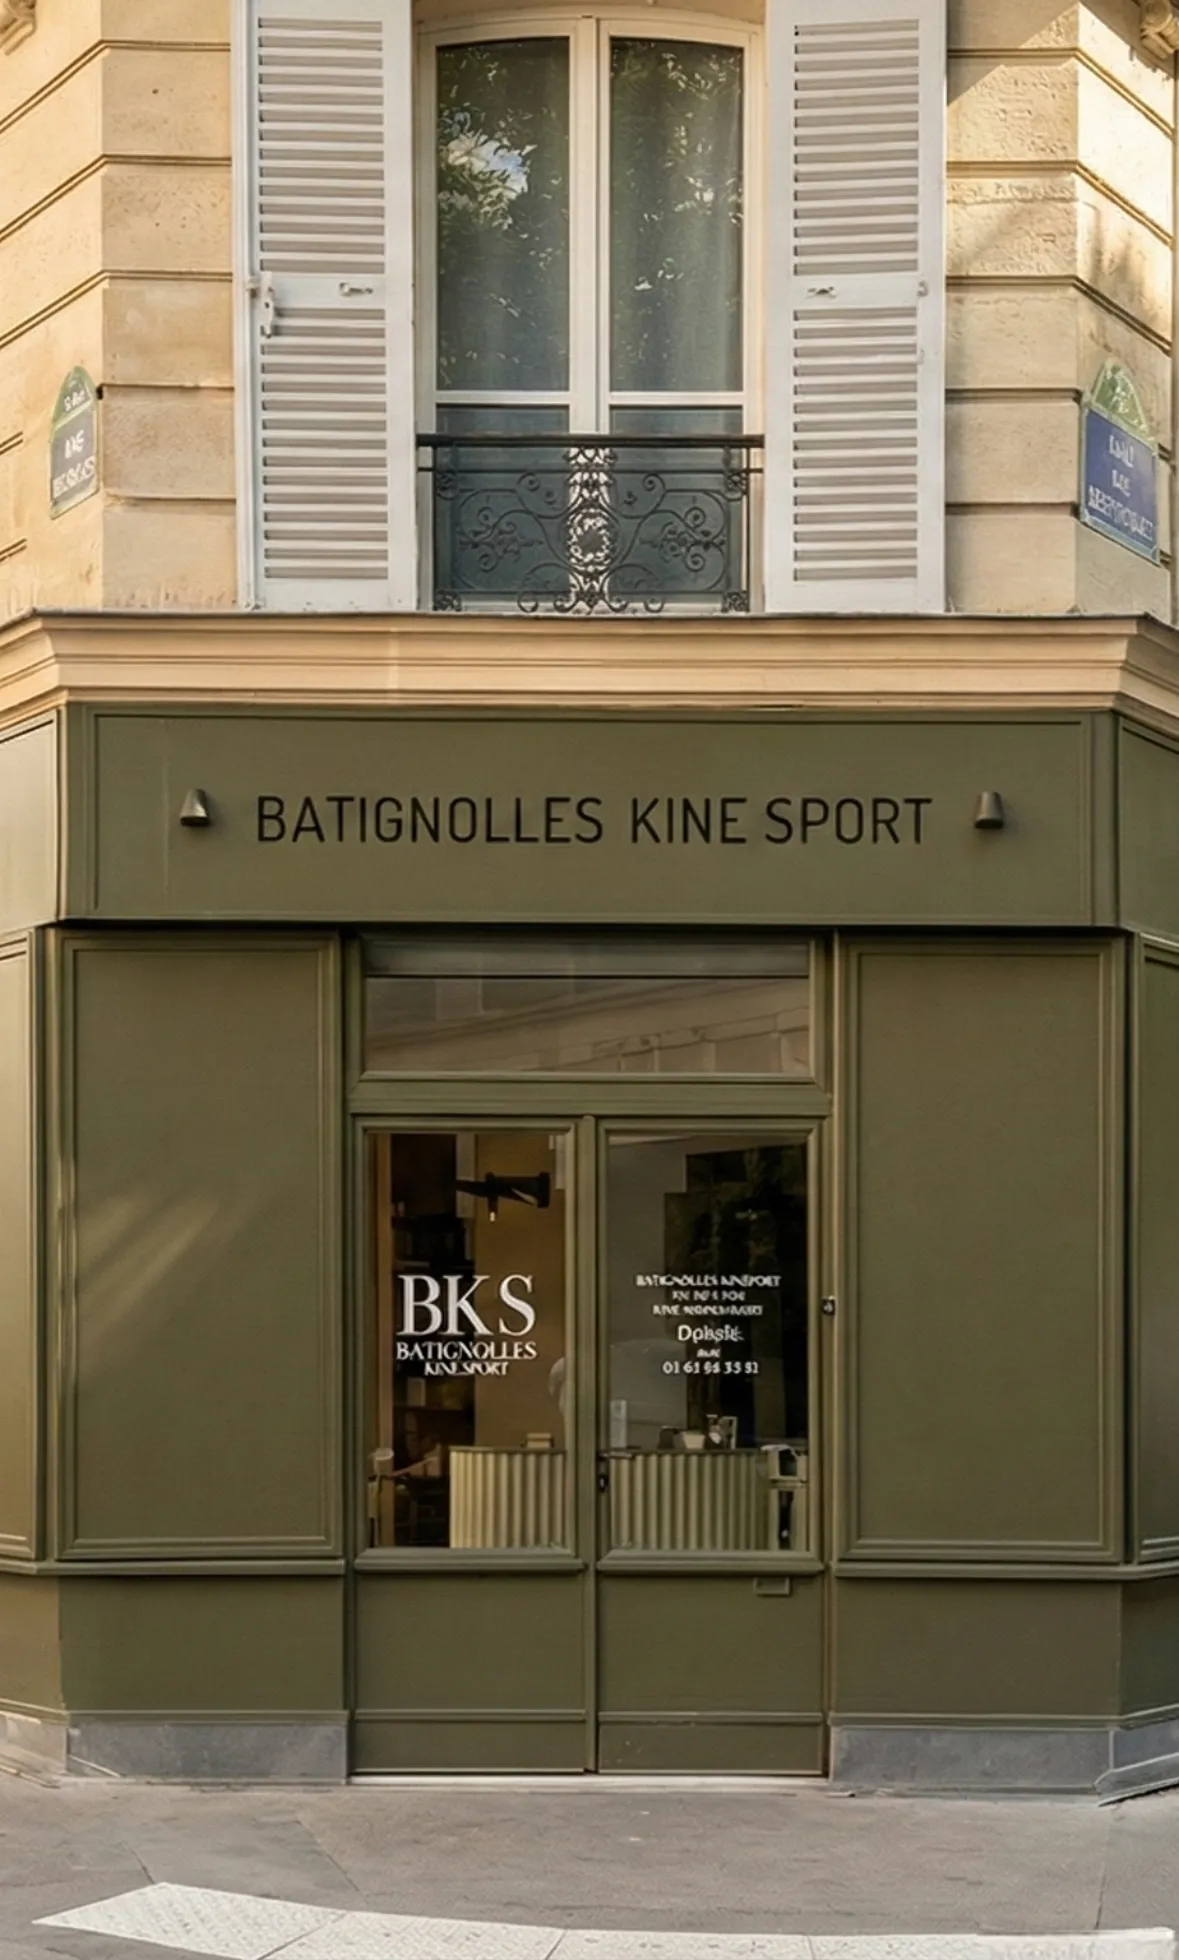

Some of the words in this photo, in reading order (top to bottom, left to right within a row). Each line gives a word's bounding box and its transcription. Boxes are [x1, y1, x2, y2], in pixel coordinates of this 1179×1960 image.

[257, 795, 603, 844] BATIGNOLLES
[631, 797, 748, 845] KINE
[765, 797, 934, 845] SPORT
[396, 1274, 536, 1336] BKS
[396, 1340, 537, 1360] BATIGNOLLES
